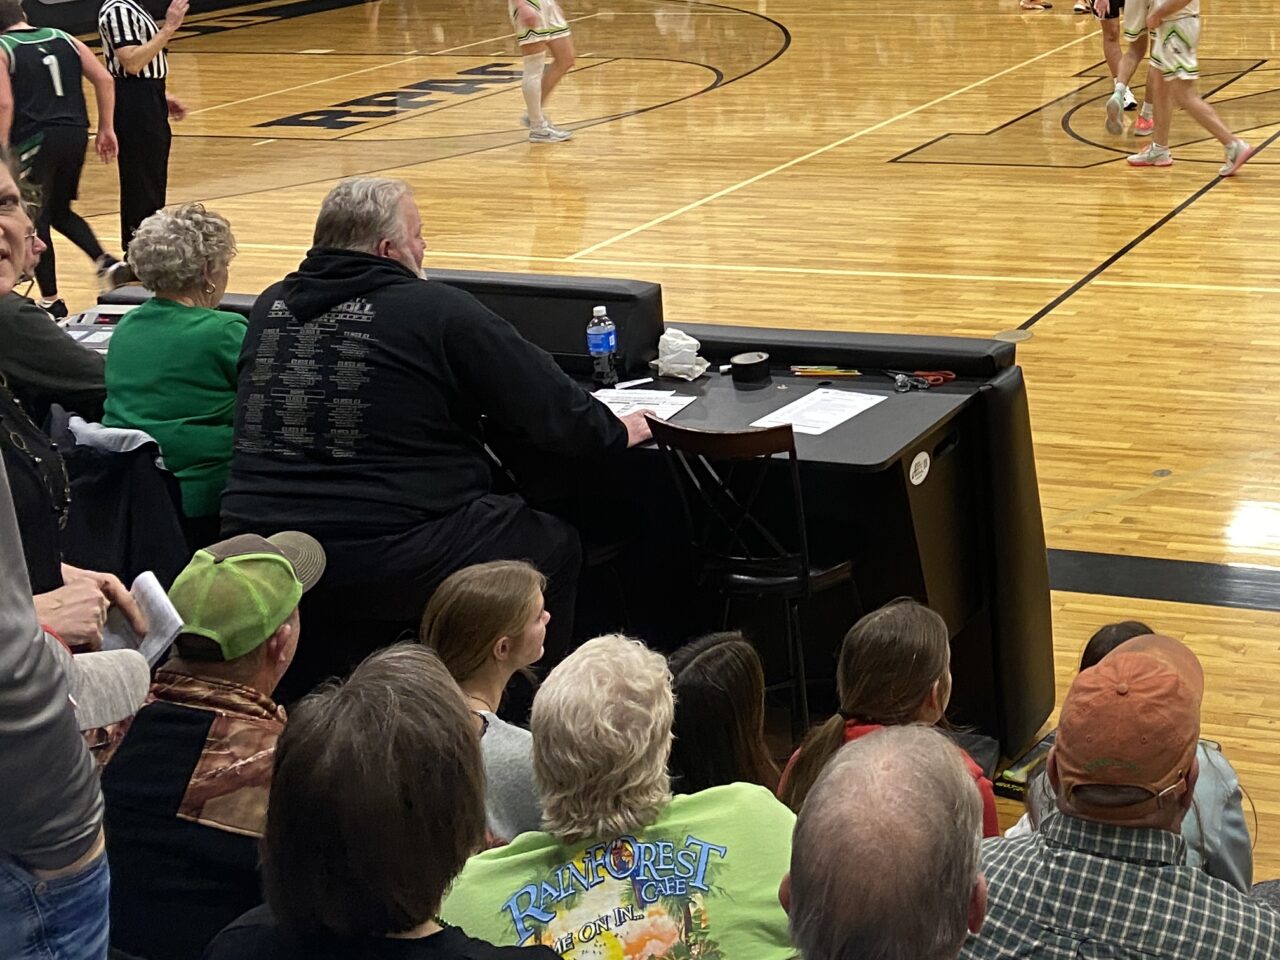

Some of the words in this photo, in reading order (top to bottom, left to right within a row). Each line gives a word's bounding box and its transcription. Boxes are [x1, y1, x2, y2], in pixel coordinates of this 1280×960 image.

[42, 53, 65, 96] 1
[502, 835, 727, 946] RAINFOREST
[641, 877, 687, 903] CAFE
[578, 916, 610, 943] ON
